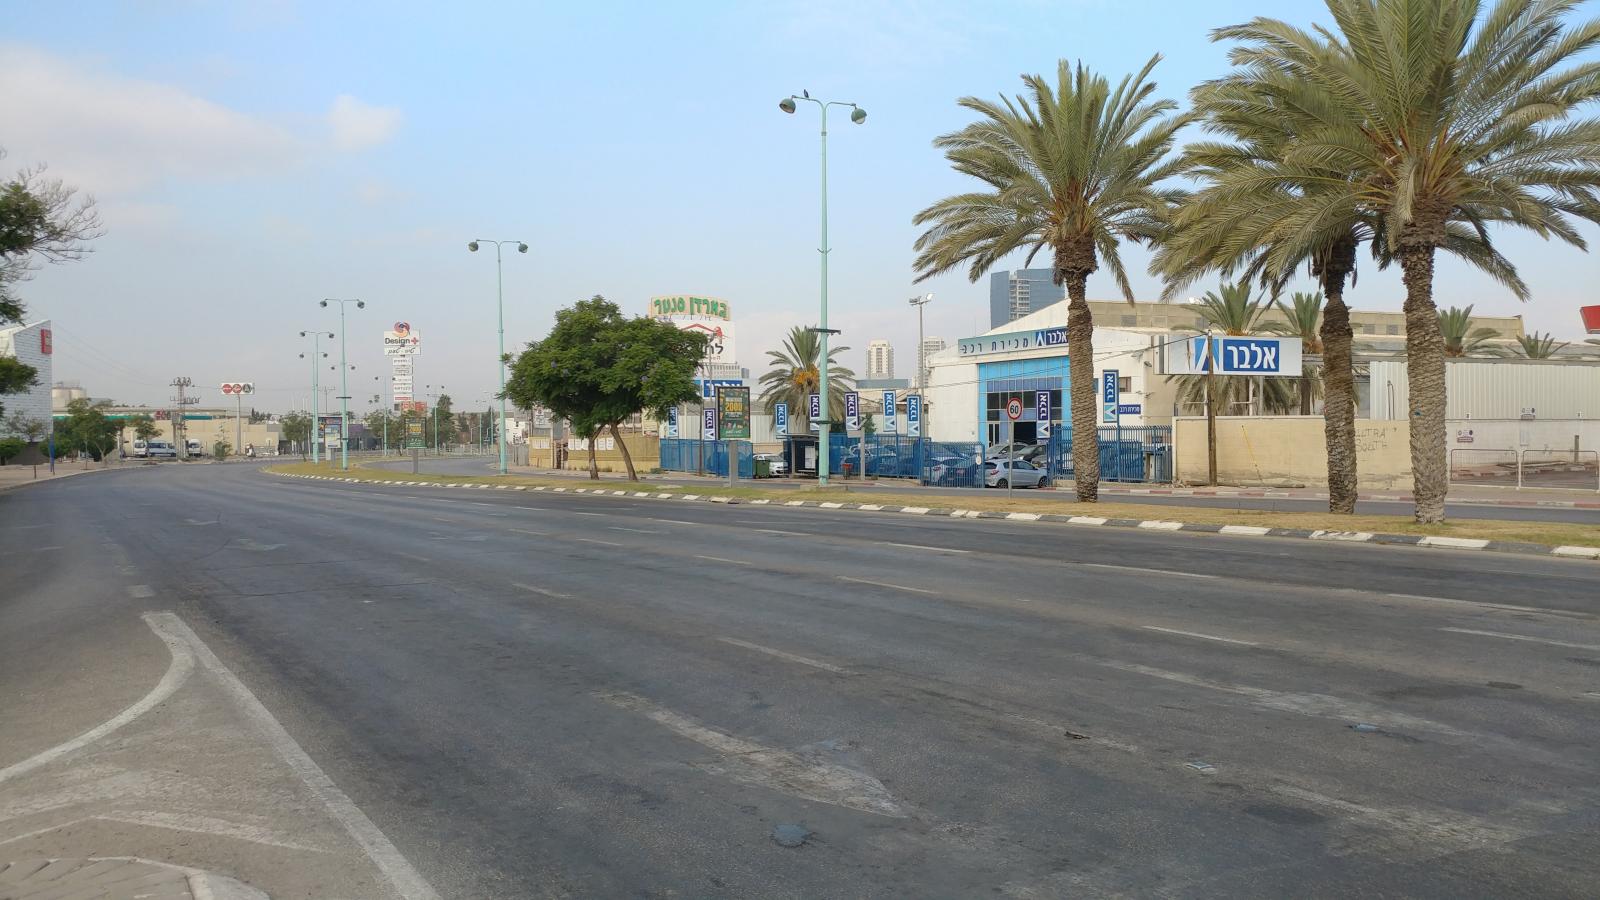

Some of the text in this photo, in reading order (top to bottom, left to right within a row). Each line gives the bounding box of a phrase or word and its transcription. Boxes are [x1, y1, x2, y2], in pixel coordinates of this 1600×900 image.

[654, 297, 686, 314] סנטר
[963, 330, 1068, 354] אלבר מכירת רכב
[1226, 342, 1276, 369] אלבר
[1106, 375, 1114, 401] אלבר
[777, 406, 785, 424] אלבר
[811, 396, 819, 416] אלבר
[1010, 405, 1019, 415] 60
[1039, 394, 1047, 419] אלבר
[705, 411, 713, 428] אלבר
